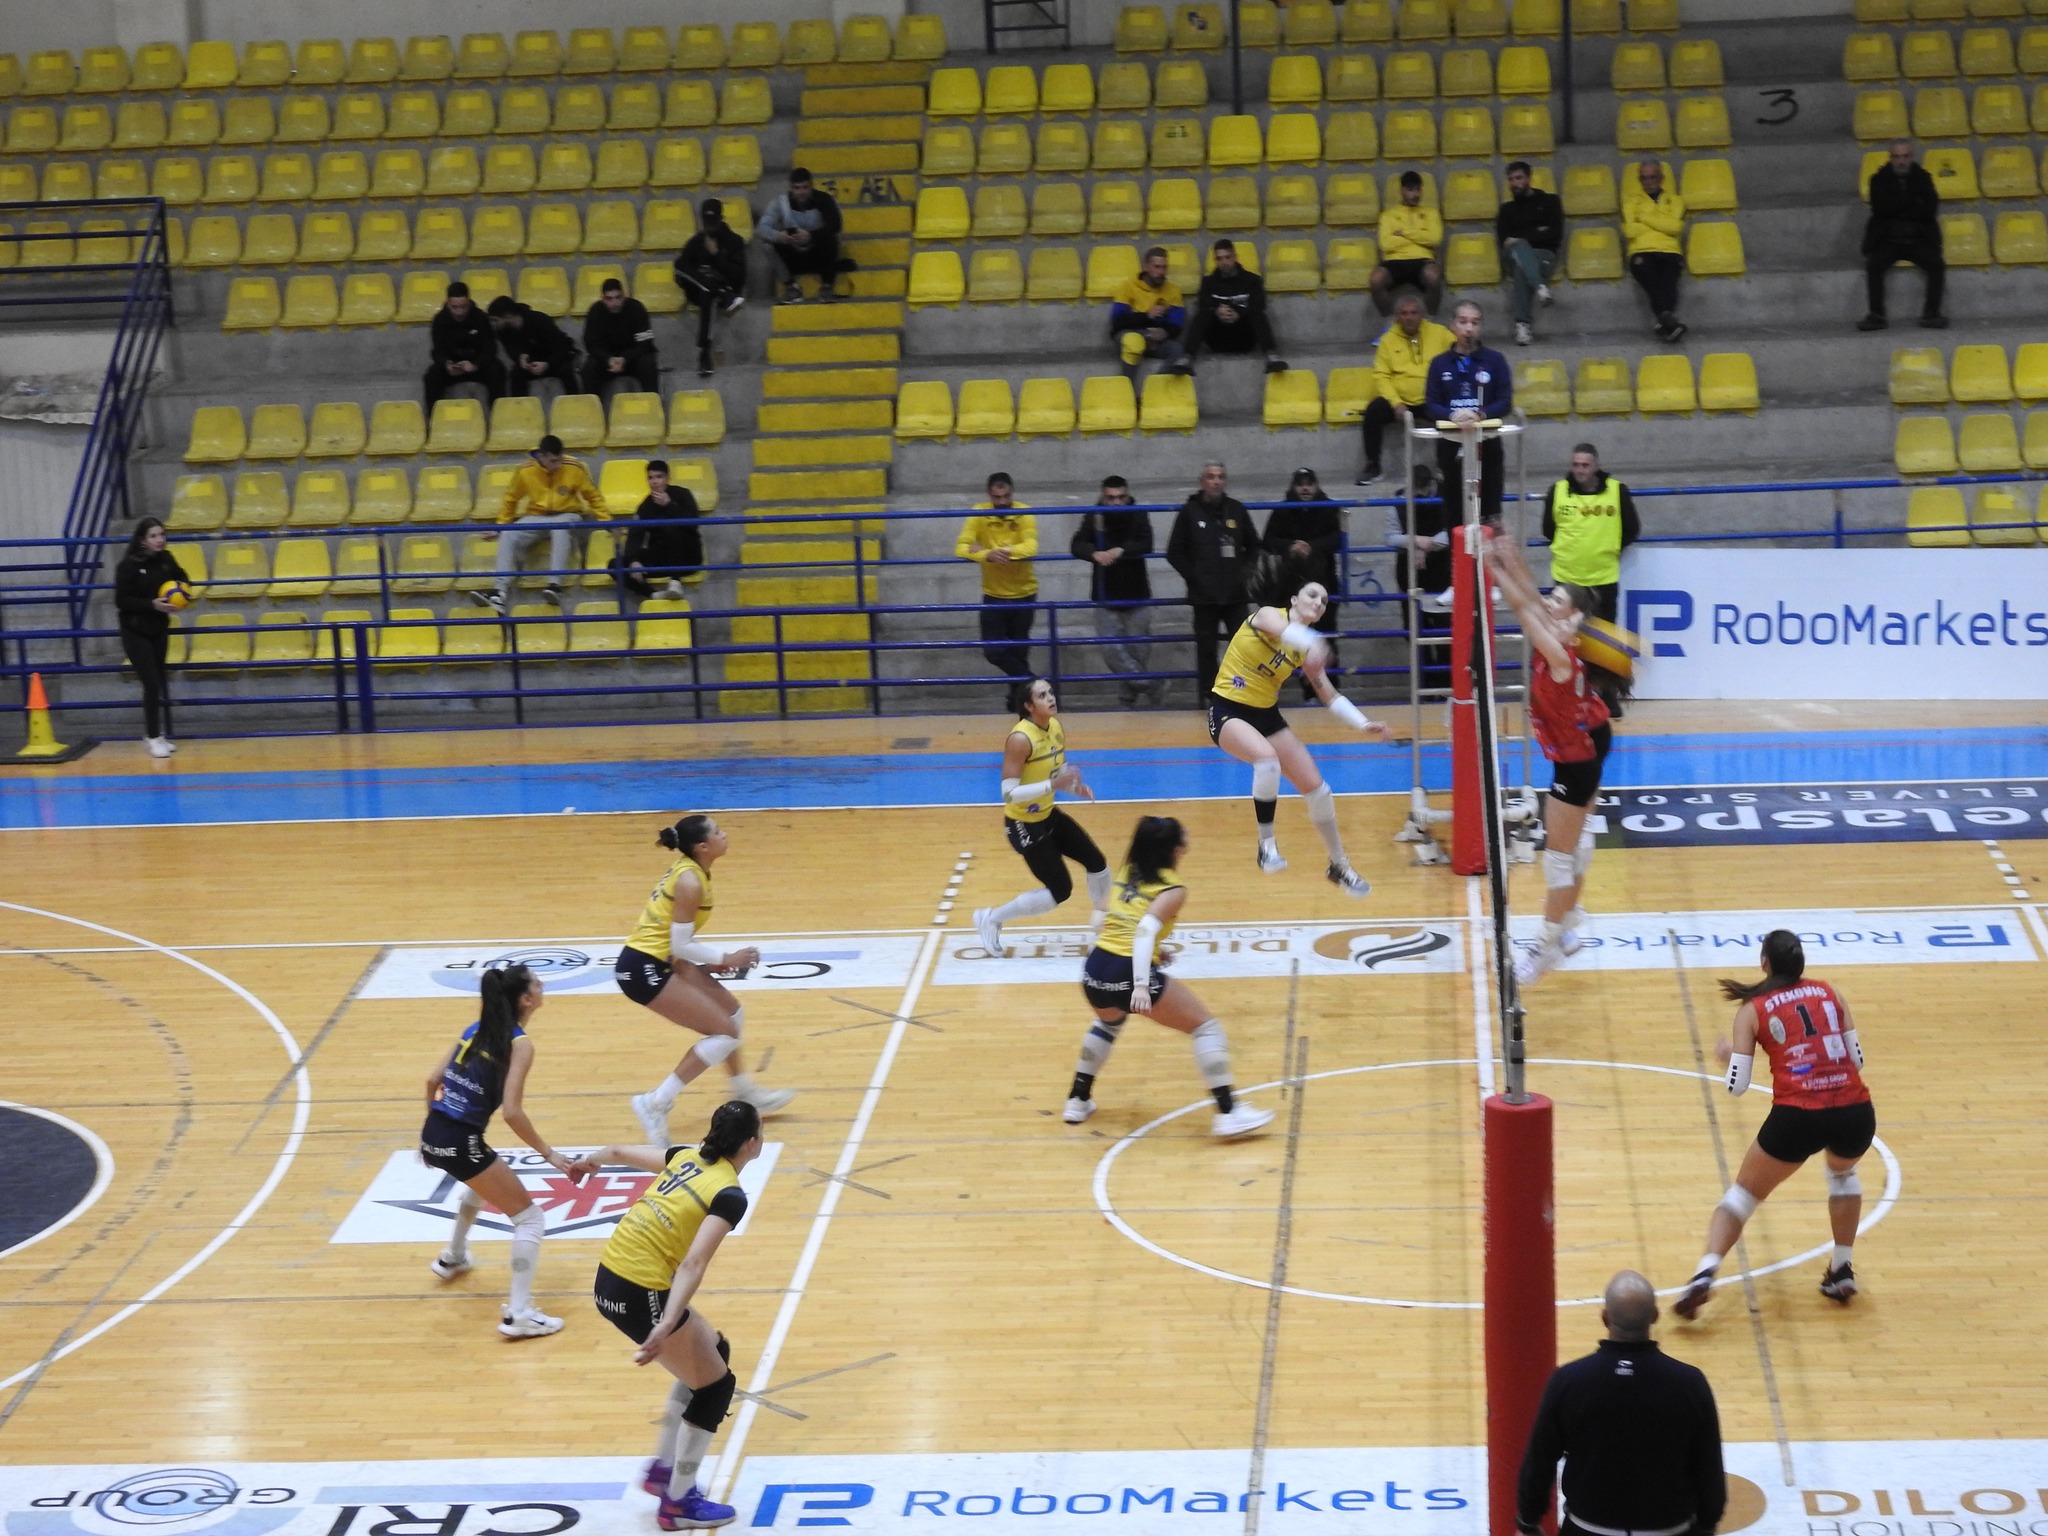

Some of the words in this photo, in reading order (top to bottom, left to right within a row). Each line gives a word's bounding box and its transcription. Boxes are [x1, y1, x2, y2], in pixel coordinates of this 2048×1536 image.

[1757, 89, 1799, 125] 3
[1714, 599, 2048, 646] RoboMarkets
[1591, 792, 1759, 807] SPOR
[1799, 786, 2039, 803] ELIVER
[1513, 927, 1903, 952] RobMarkes
[657, 1162, 703, 1196] 37
[30, 1486, 297, 1508] GROUP
[902, 1481, 1469, 1519] RoboMarkets
[1801, 1488, 2048, 1516] DILO
[326, 1503, 581, 1536] CRI
